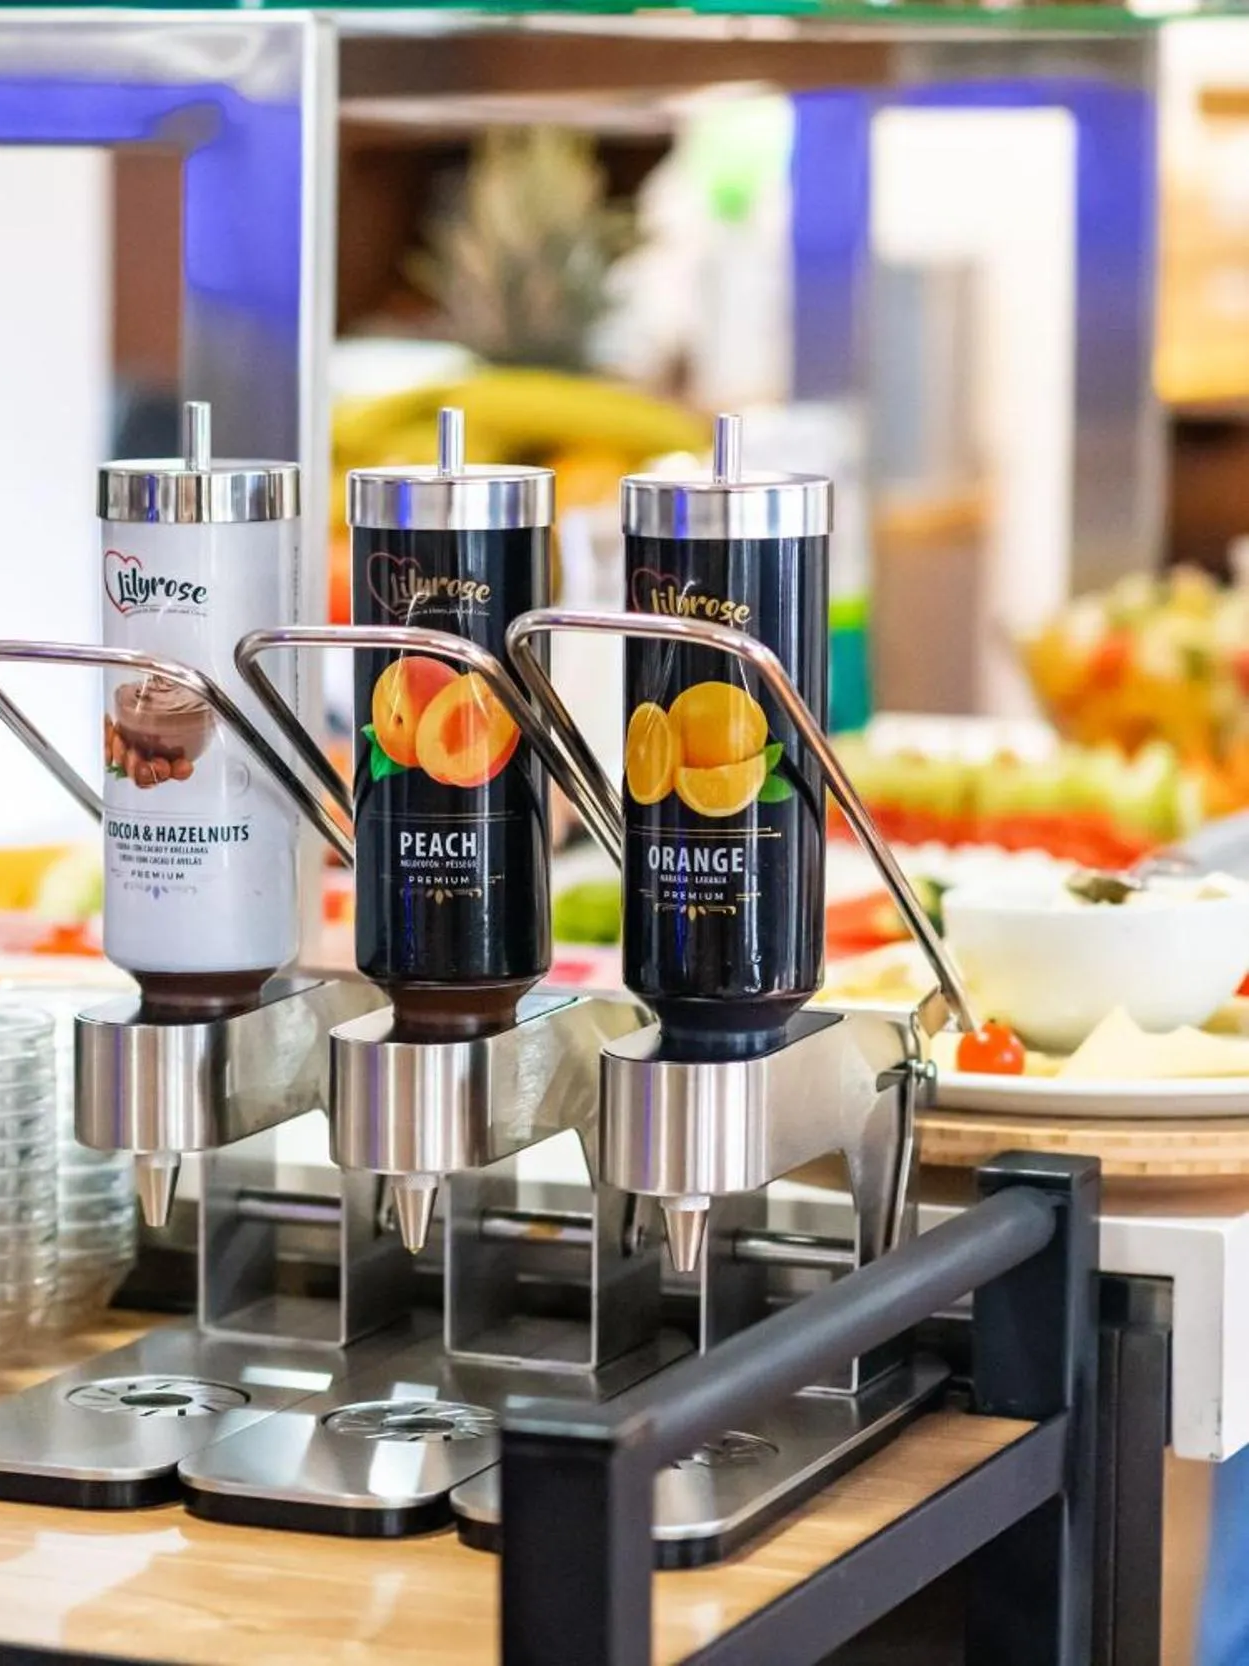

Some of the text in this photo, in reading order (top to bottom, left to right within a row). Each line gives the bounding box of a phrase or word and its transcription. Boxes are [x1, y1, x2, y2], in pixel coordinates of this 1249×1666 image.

[117, 567, 208, 605] Lilyrose
[142, 825, 153, 842] &
[155, 824, 250, 843] HAZELNUTS
[400, 831, 477, 858] PEACH
[648, 846, 745, 873] ORANGE
[131, 869, 185, 881] PREMIUM
[408, 875, 470, 885] PREMIUM
[663, 890, 724, 901] PREMIUM
